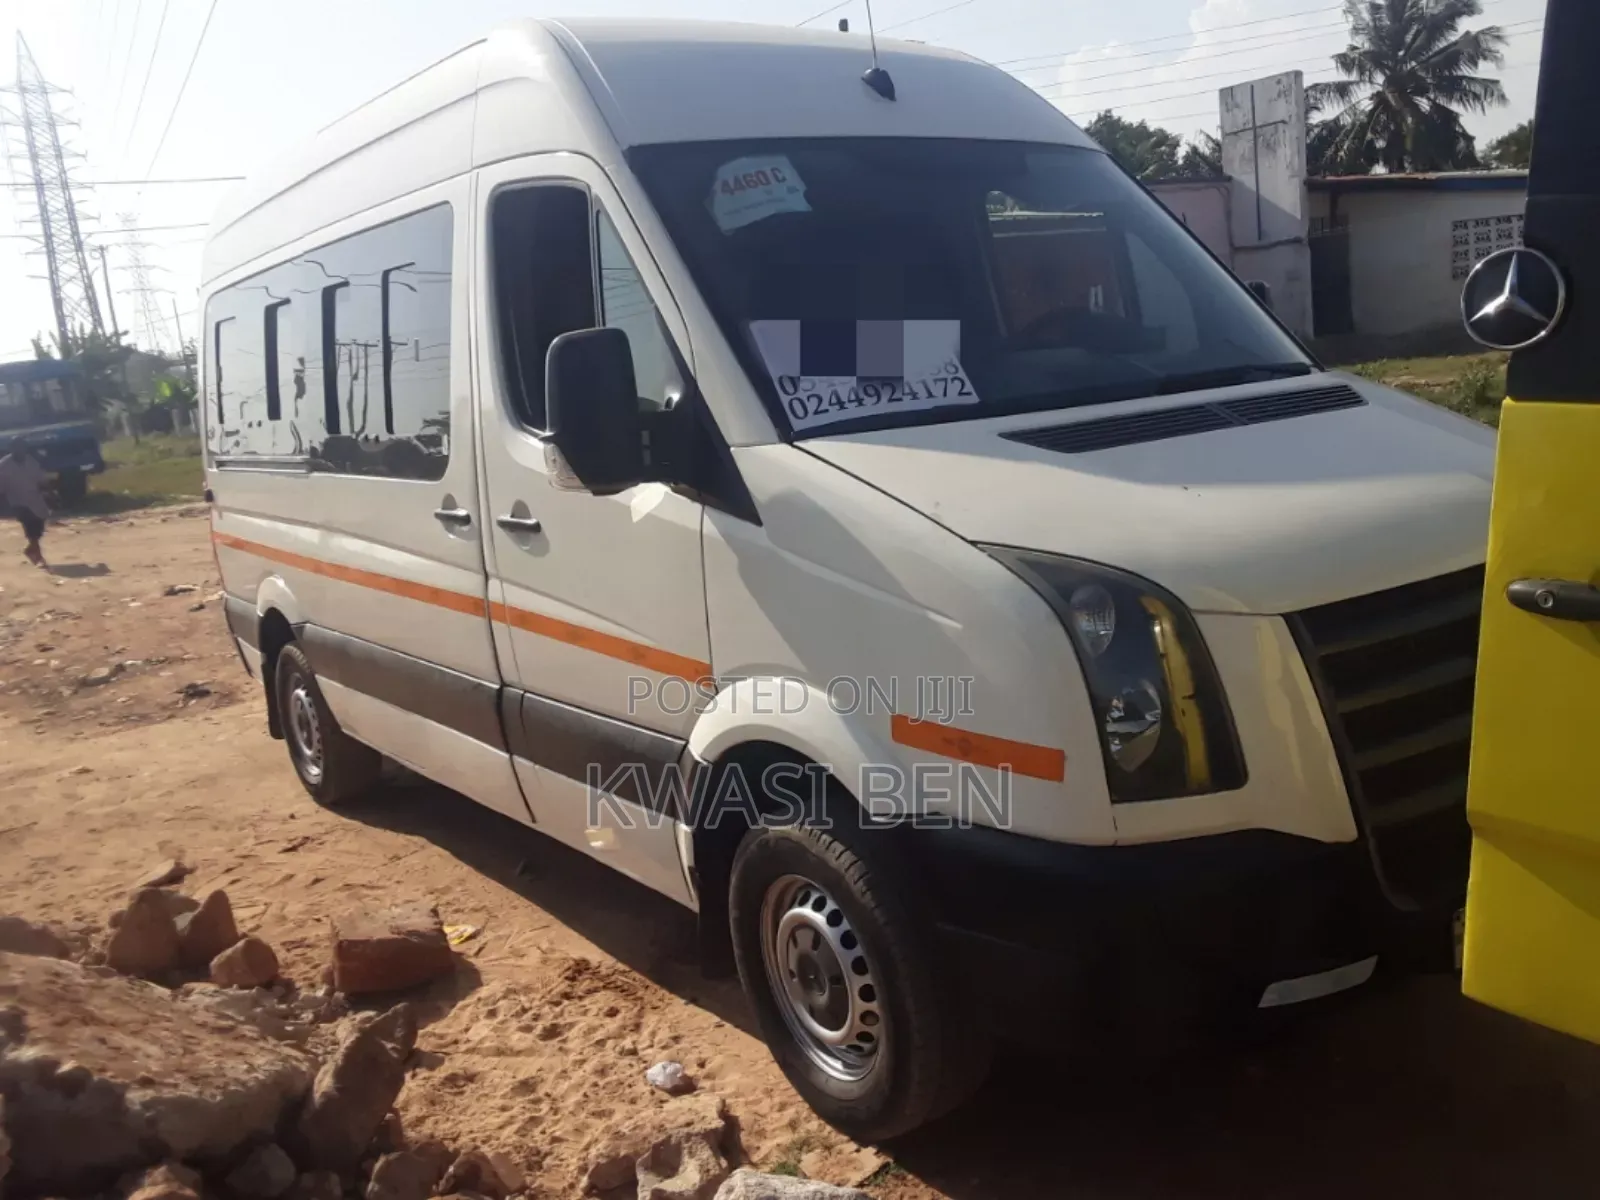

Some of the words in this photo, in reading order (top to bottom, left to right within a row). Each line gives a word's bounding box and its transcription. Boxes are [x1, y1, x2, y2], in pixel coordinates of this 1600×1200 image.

[721, 169, 772, 196] 4460
[770, 166, 788, 184] C
[787, 377, 972, 420] 0244924172
